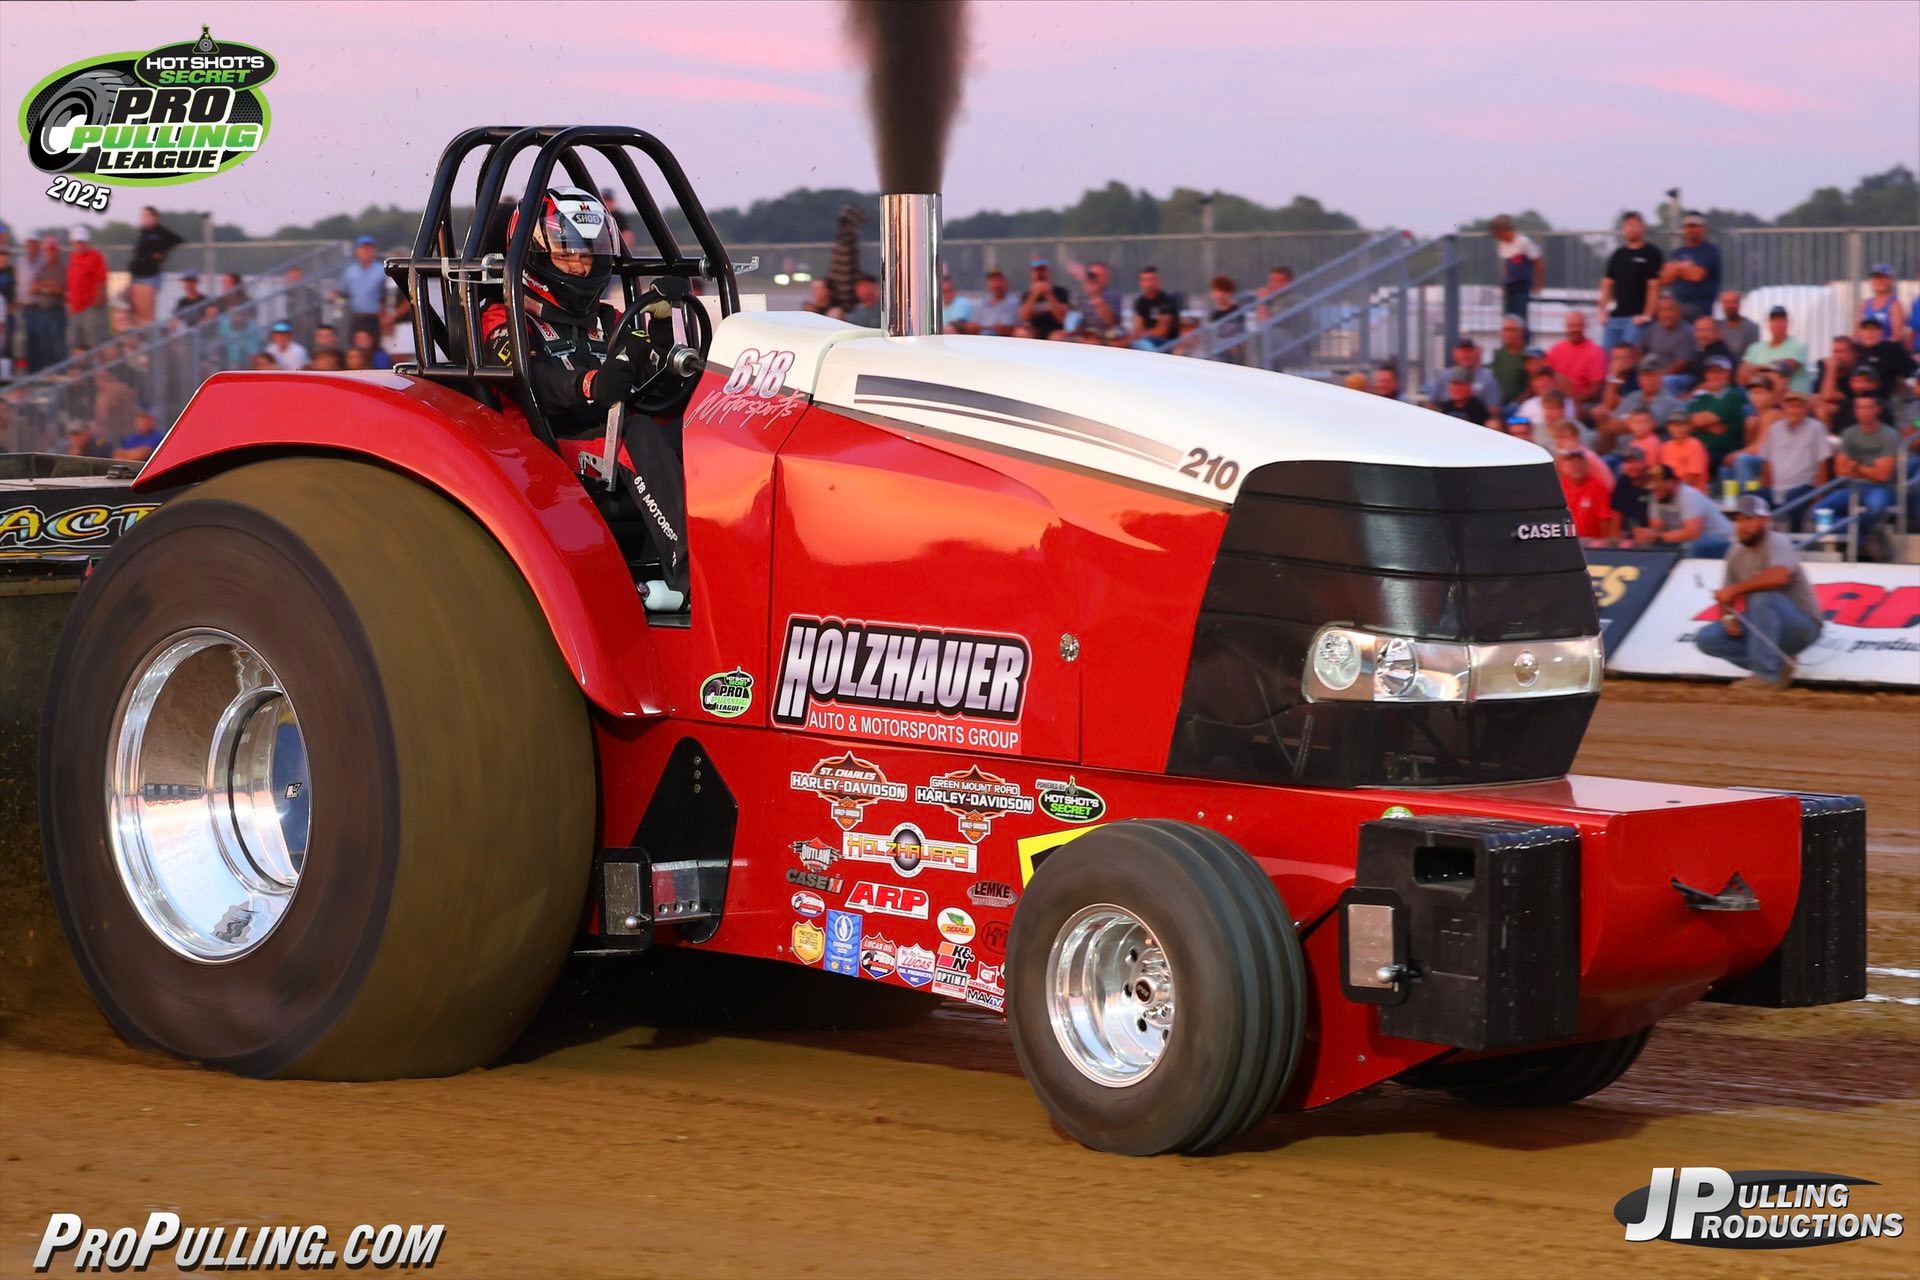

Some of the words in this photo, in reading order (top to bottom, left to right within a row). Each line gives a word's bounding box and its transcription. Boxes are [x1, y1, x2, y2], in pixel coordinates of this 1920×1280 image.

[723, 348, 796, 398] 618
[1179, 447, 1240, 490] 210
[634, 475, 646, 494] 618
[1518, 524, 1561, 540] CASE
[777, 625, 1025, 718] HOLZHAUER
[720, 686, 743, 698] PRO
[809, 710, 845, 730] AUTO
[848, 715, 858, 732] &
[861, 716, 965, 744] MOTORSPORTS
[968, 728, 1019, 749] GROUP
[820, 767, 834, 776] ST.
[835, 769, 876, 780] CHARLES
[792, 775, 905, 799] HARLEY-DAVIDSON
[931, 779, 960, 789] GREEN
[961, 782, 993, 793] MOUNT
[994, 785, 1018, 795] ROAD
[917, 788, 1033, 812] HARLEY-DAVIDSON
[1044, 793, 1065, 804] HOT
[1050, 803, 1093, 816] SECRET
[801, 843, 832, 865] OUTLAW
[847, 834, 969, 869] HOLZHAUERS
[786, 867, 828, 890] CASE
[849, 882, 927, 912] ARP
[974, 881, 1011, 899] LEMKE
[945, 925, 970, 934] DEKALB
[864, 940, 883, 950] LUCAS
[883, 943, 893, 952] OIL
[902, 956, 932, 970] LUCAS
[936, 970, 967, 988] OPTIMA
